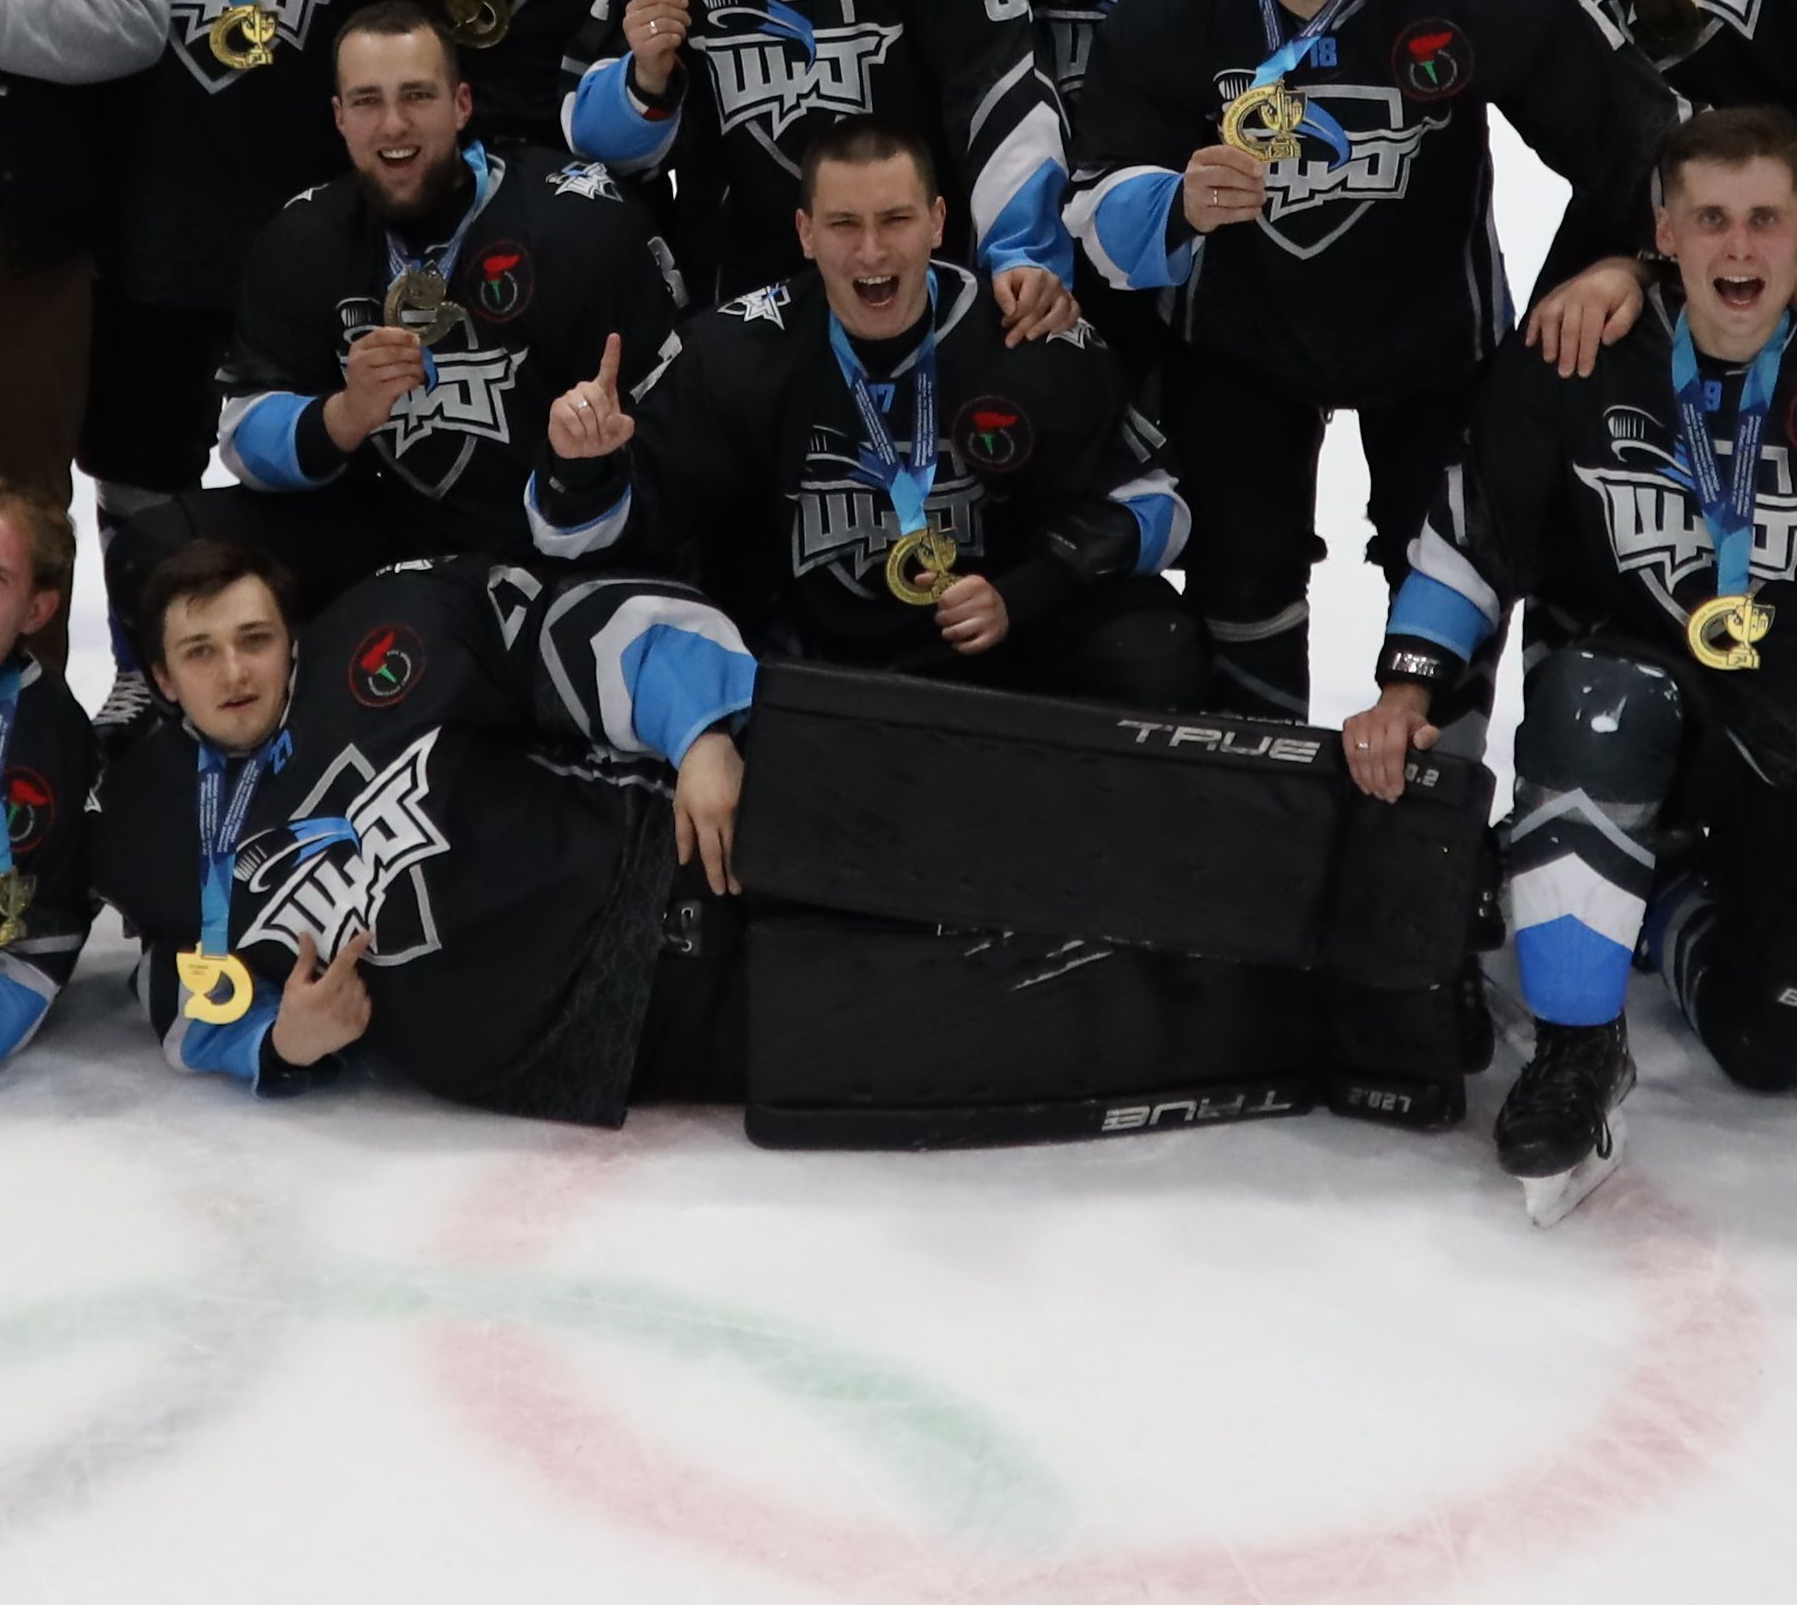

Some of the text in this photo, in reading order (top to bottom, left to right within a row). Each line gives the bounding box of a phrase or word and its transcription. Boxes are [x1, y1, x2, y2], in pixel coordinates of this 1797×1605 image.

[712, 33, 882, 117] ЩИТ
[1115, 719, 1323, 765] TRUE
[1404, 763, 1441, 787] 0.2
[1099, 1090, 1294, 1132] TRUE
